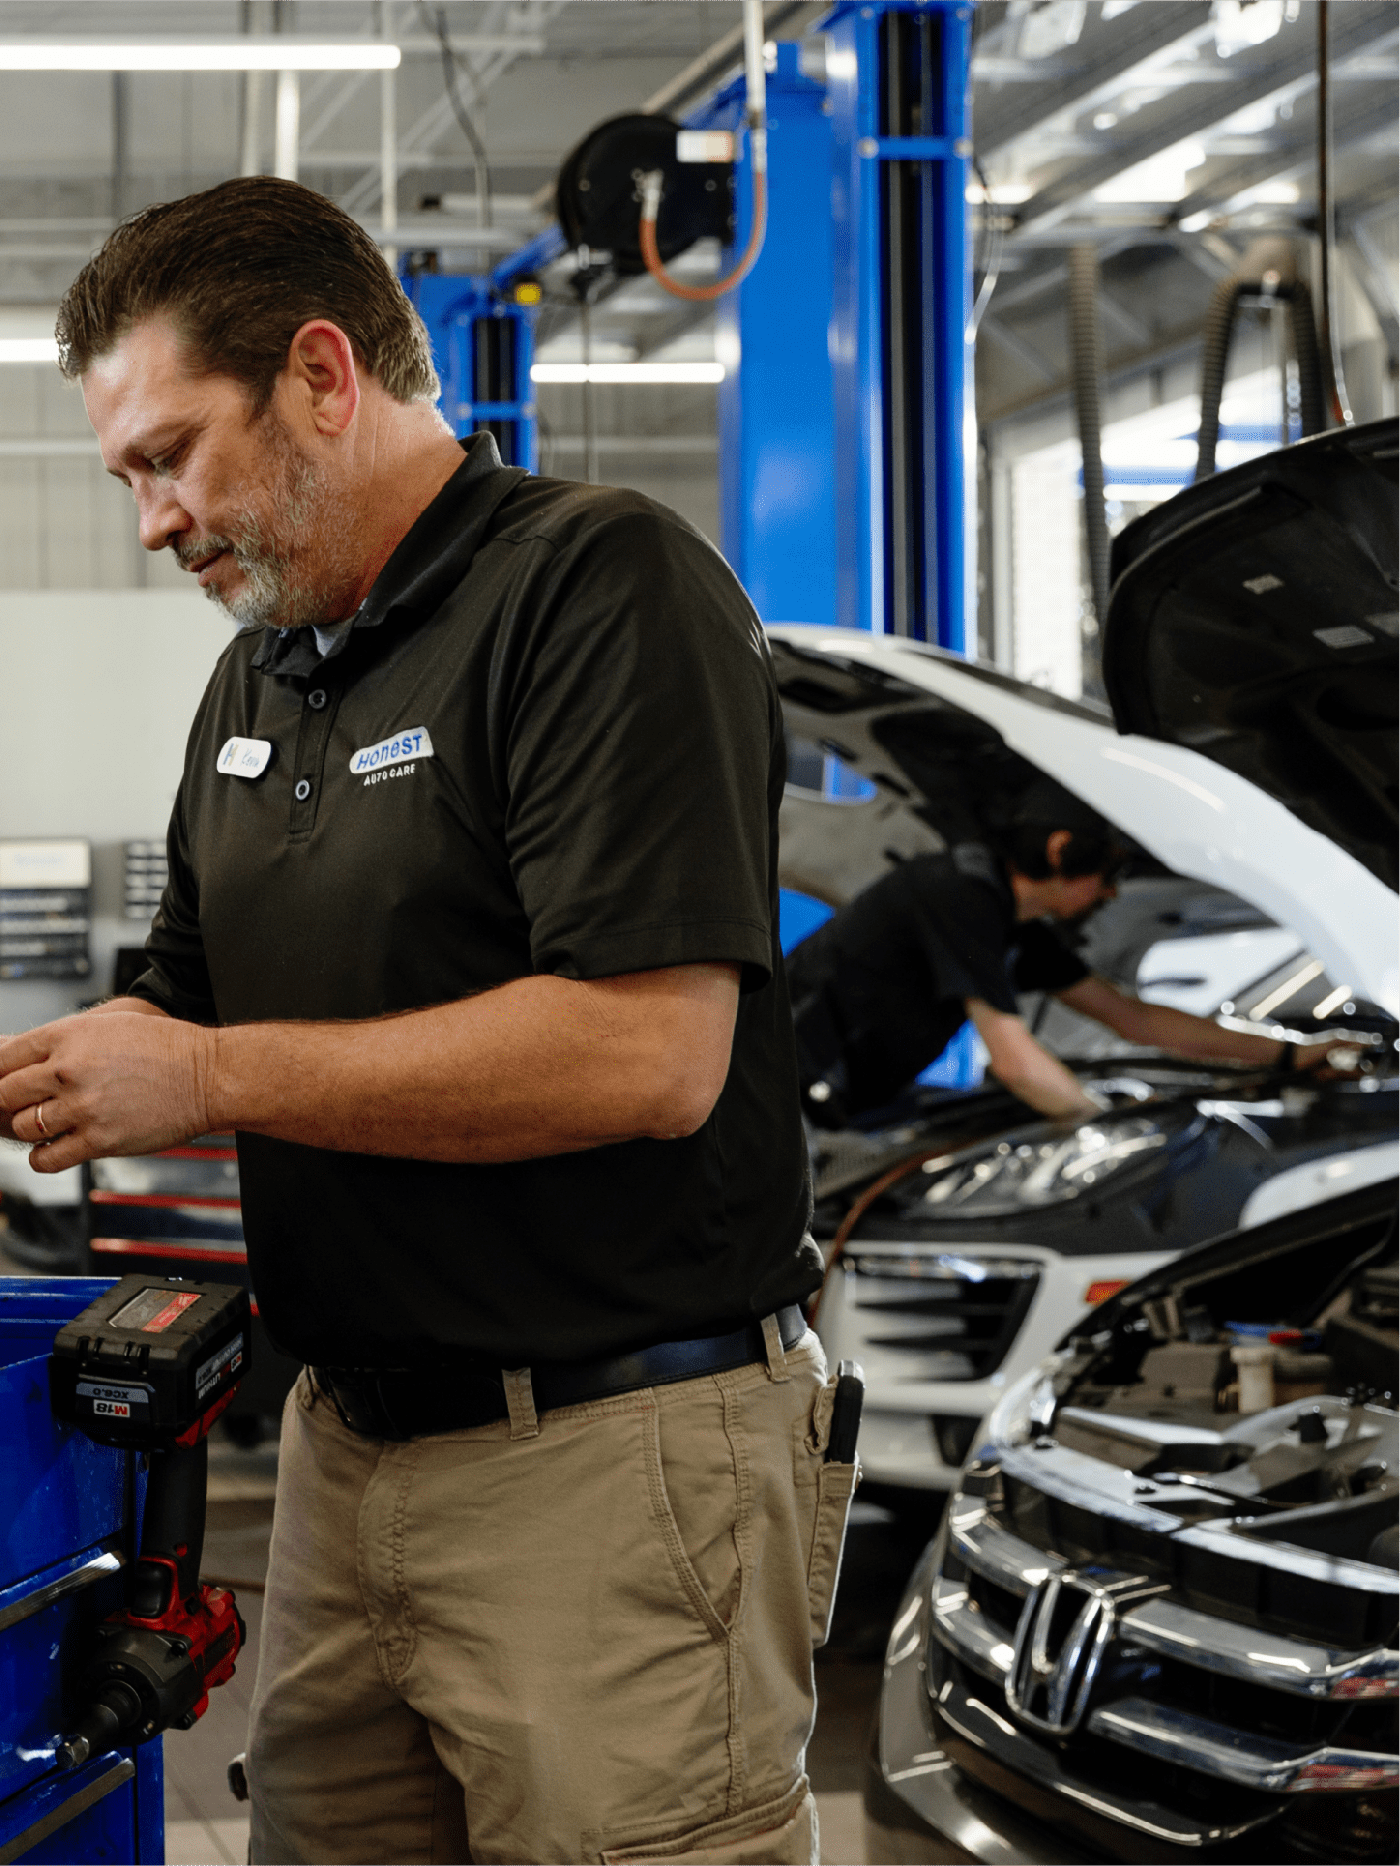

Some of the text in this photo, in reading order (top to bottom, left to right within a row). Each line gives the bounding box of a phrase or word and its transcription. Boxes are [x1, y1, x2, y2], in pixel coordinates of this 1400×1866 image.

[363, 763, 416, 787] AUTO CARE
[95, 1402, 128, 1416] M18
